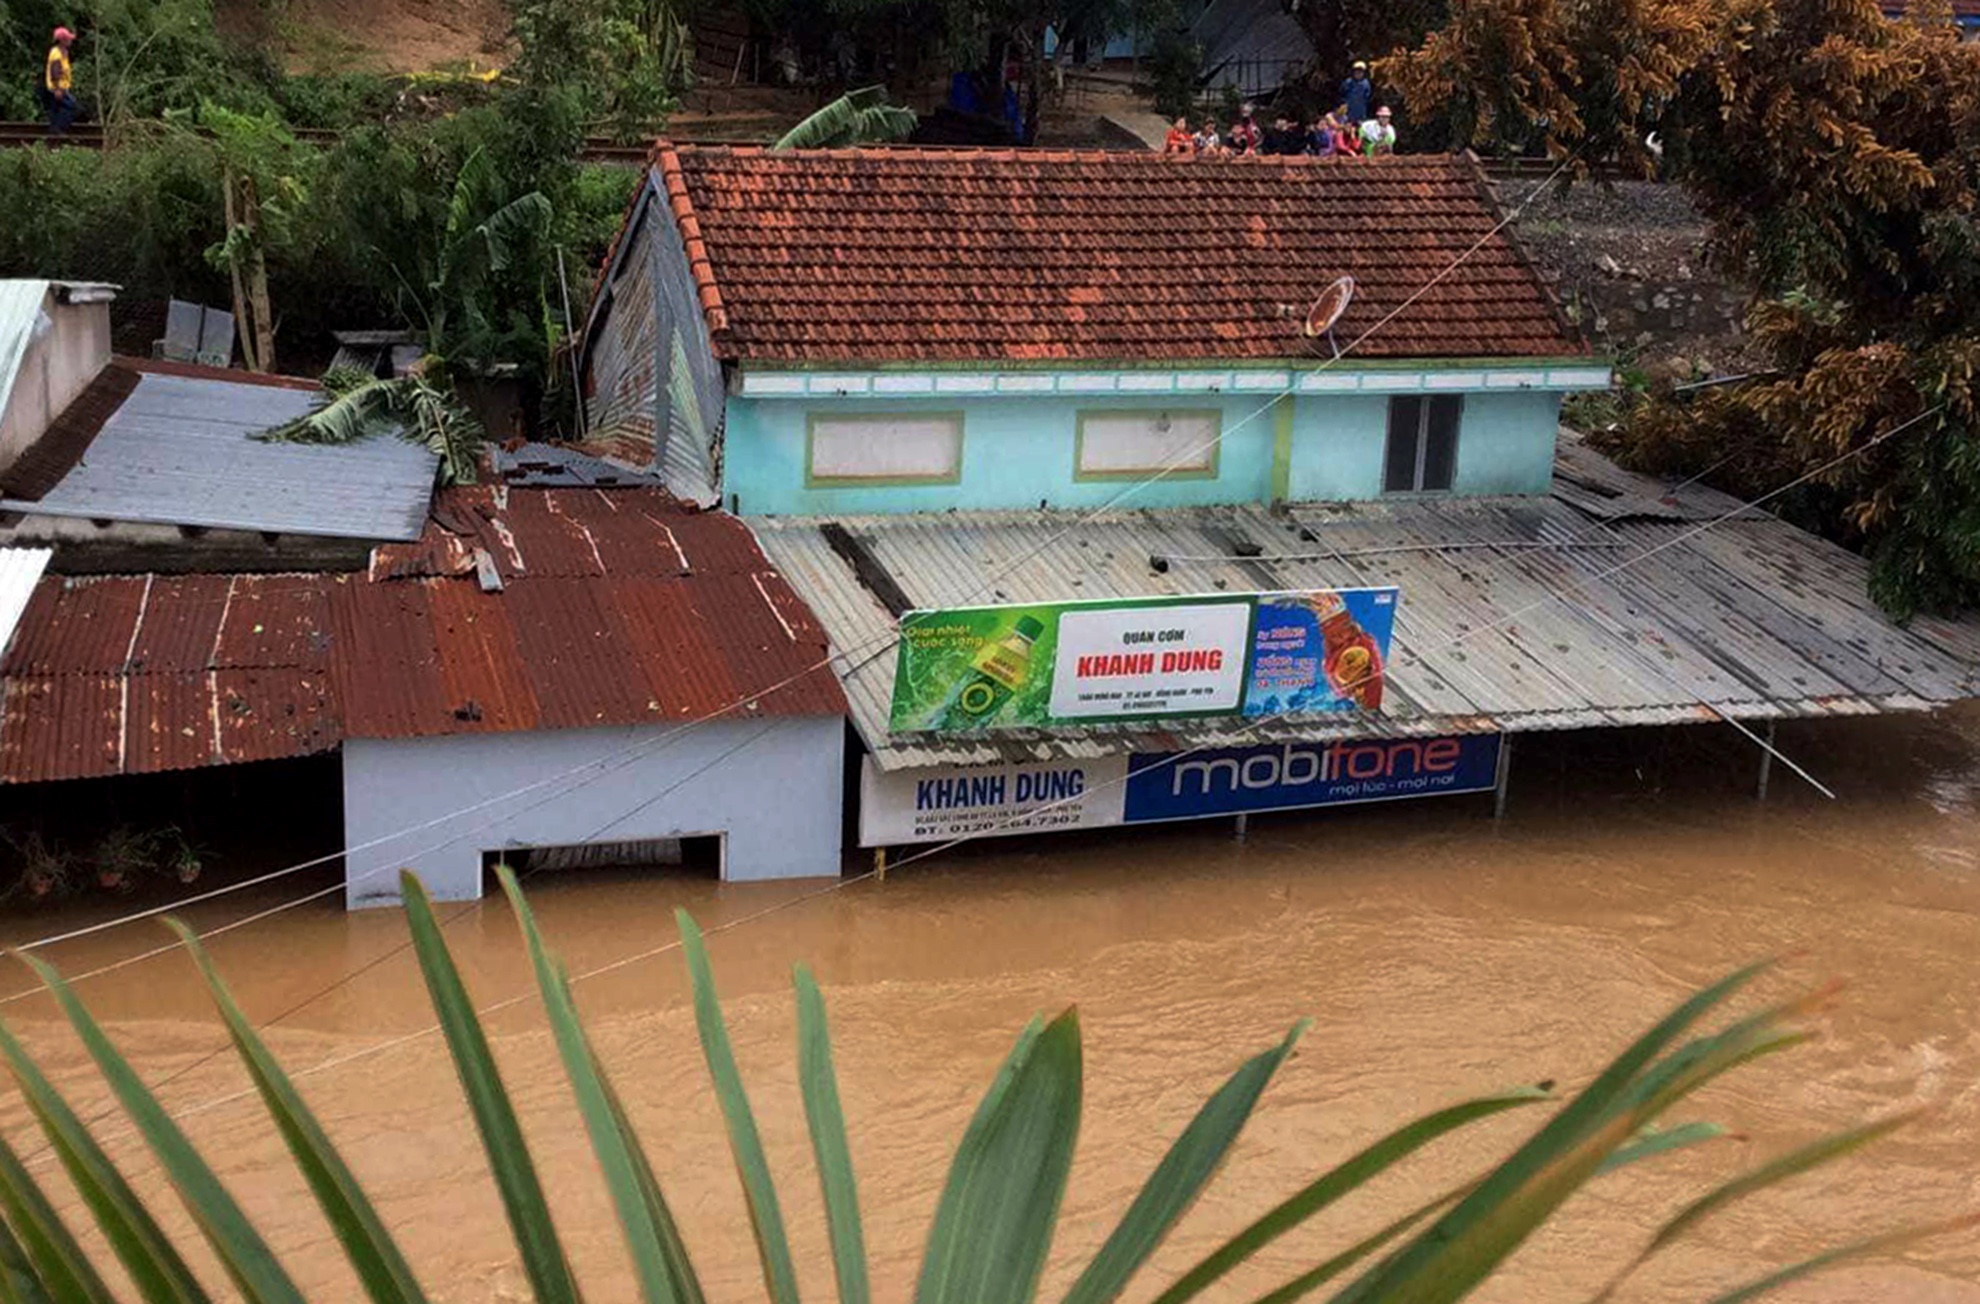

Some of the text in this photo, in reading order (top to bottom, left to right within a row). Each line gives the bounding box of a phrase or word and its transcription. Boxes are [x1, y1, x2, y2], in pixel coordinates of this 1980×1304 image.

[1158, 628, 1185, 642] CƠM
[1077, 648, 1223, 678] KHANH DUNG
[1173, 737, 1460, 796] mobifone
[917, 768, 1085, 811] KHANH DUNG
